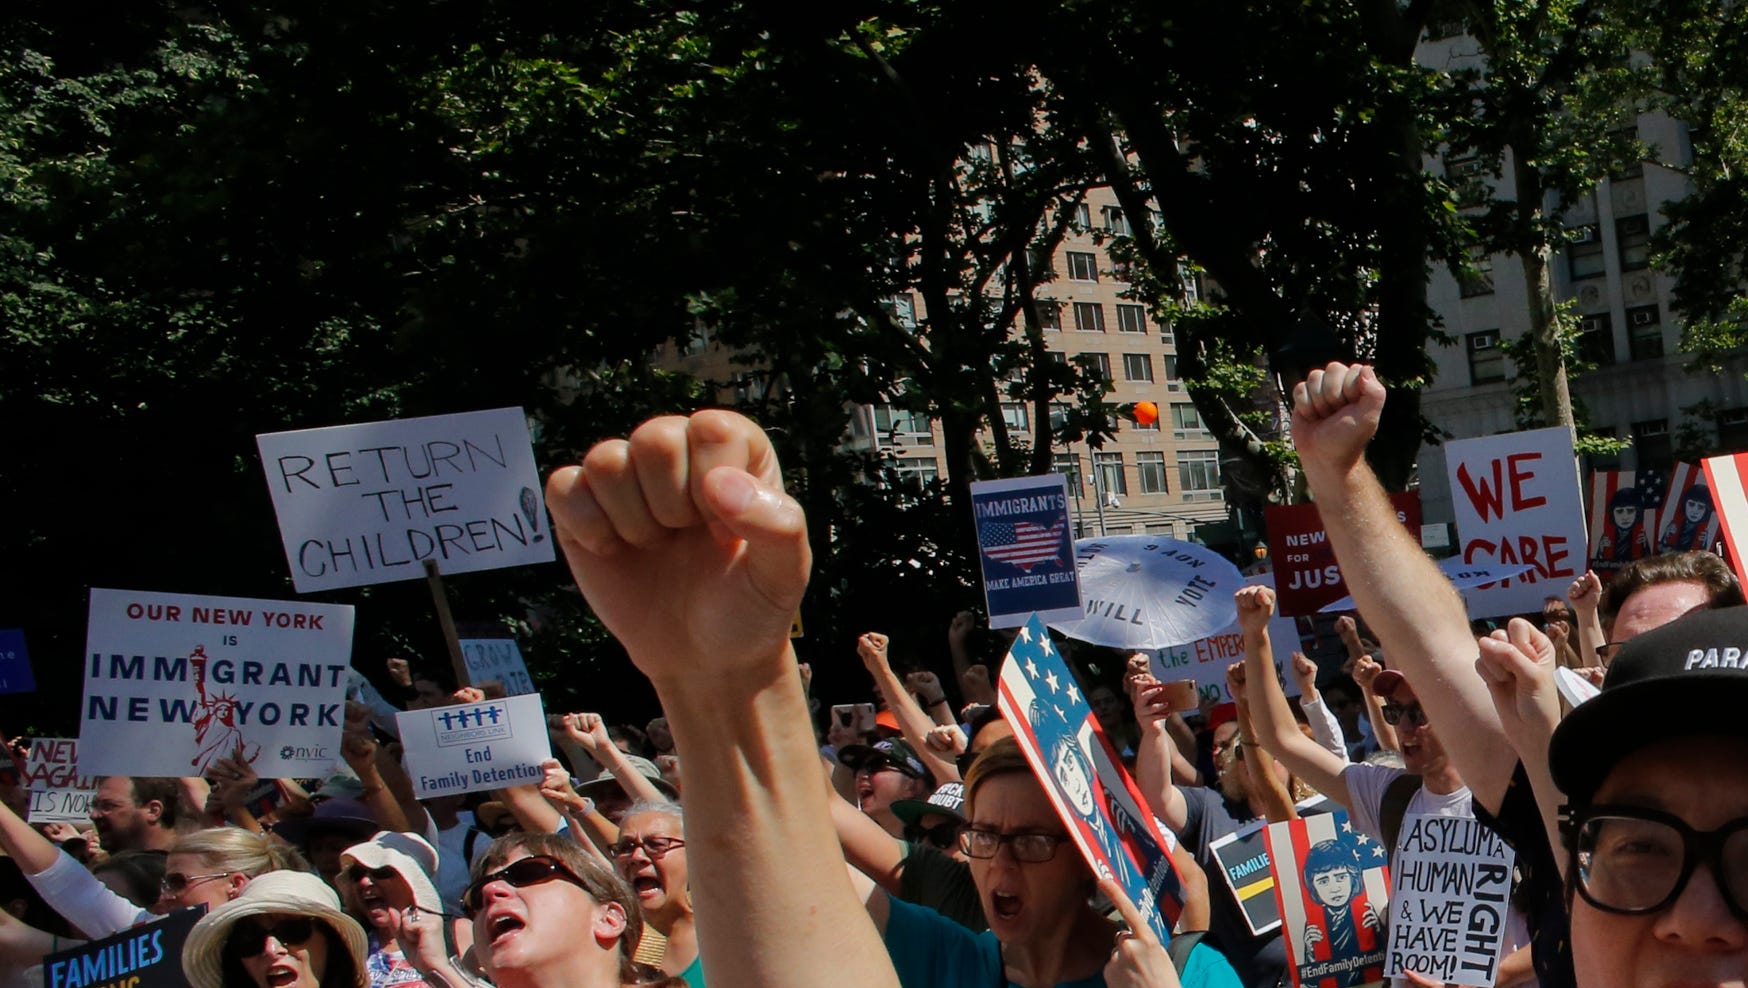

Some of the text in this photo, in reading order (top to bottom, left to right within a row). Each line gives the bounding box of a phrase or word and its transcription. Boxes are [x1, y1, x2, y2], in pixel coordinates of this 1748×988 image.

[278, 434, 507, 493] RETURN
[361, 483, 459, 522] THE
[1457, 452, 1547, 524] WE
[976, 493, 1066, 519] IMMIGRANTS
[299, 486, 545, 577] CHILDREN!
[1286, 531, 1327, 547] NEW
[1287, 553, 1310, 564] FOR
[1464, 536, 1574, 590] CARE
[986, 571, 1075, 592] MAKE AMERICA GREAT
[1288, 565, 1341, 590] JUS
[1087, 600, 1144, 626] WILL
[1175, 574, 1217, 608] VOTE
[127, 603, 324, 630] OUR NEW YORK
[223, 635, 238, 646] IS
[92, 653, 345, 688] IMMIGRANT
[1158, 648, 1190, 670] the
[88, 695, 340, 727] NEW YORK
[466, 746, 492, 764] End
[420, 763, 545, 792] Family Detention
[30, 790, 57, 812] IS
[1402, 818, 1495, 857] ASYLUM
[1228, 853, 1270, 881] FAMILIE
[1398, 860, 1476, 896] HUMAN
[1400, 898, 1465, 925] & WE
[1461, 863, 1507, 981] RIGHT
[1394, 924, 1458, 953] HAVE
[1390, 952, 1458, 981] ROOM!
